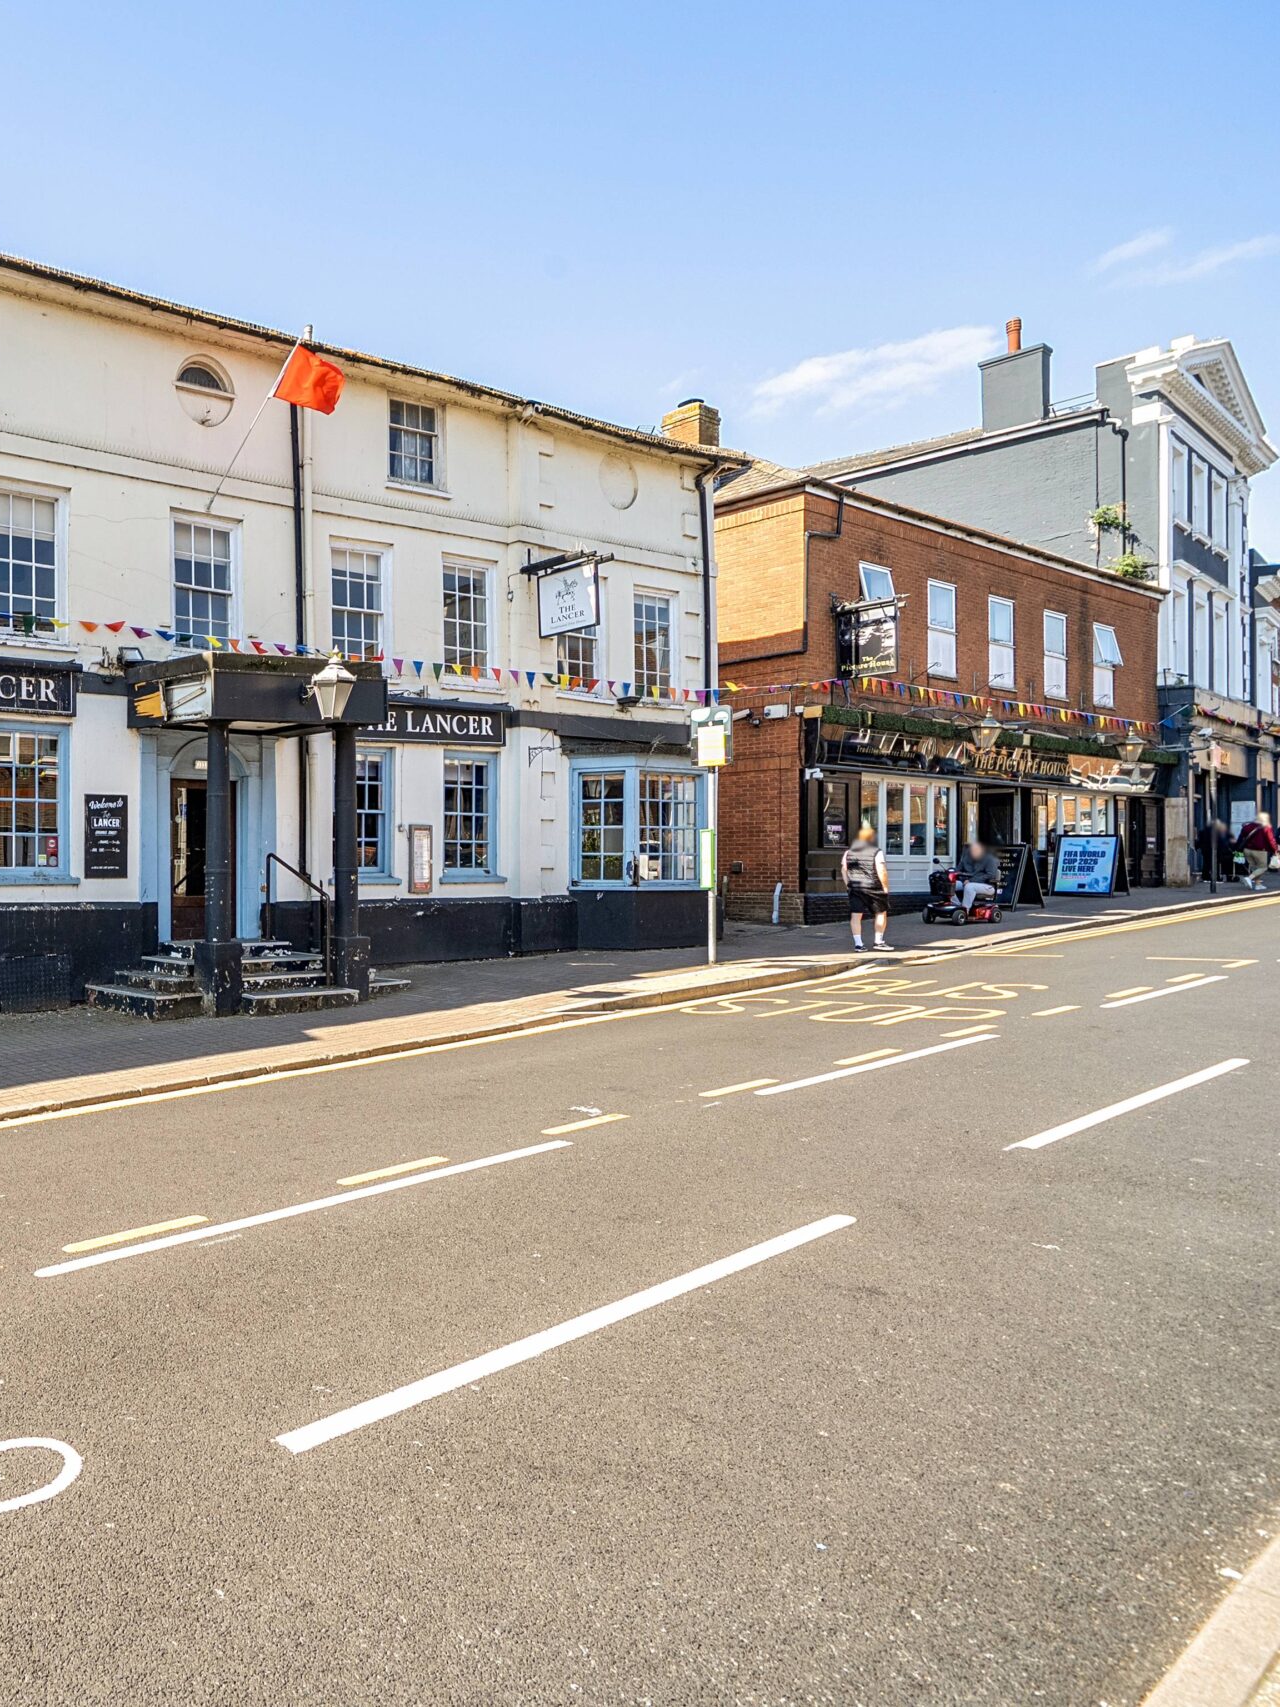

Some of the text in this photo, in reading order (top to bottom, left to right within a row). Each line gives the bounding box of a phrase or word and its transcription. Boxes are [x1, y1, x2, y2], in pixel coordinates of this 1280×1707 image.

[551, 610, 585, 624] LANCER
[559, 604, 575, 614] THE
[405, 710, 494, 736] LANCER
[974, 753, 1072, 777] THE PICTURE HOUSE
[93, 818, 120, 828] LANCER
[1063, 850, 1106, 858] FIFA WORLD
[804, 978, 1049, 1000] BUS
[679, 998, 1008, 1026] STOP
